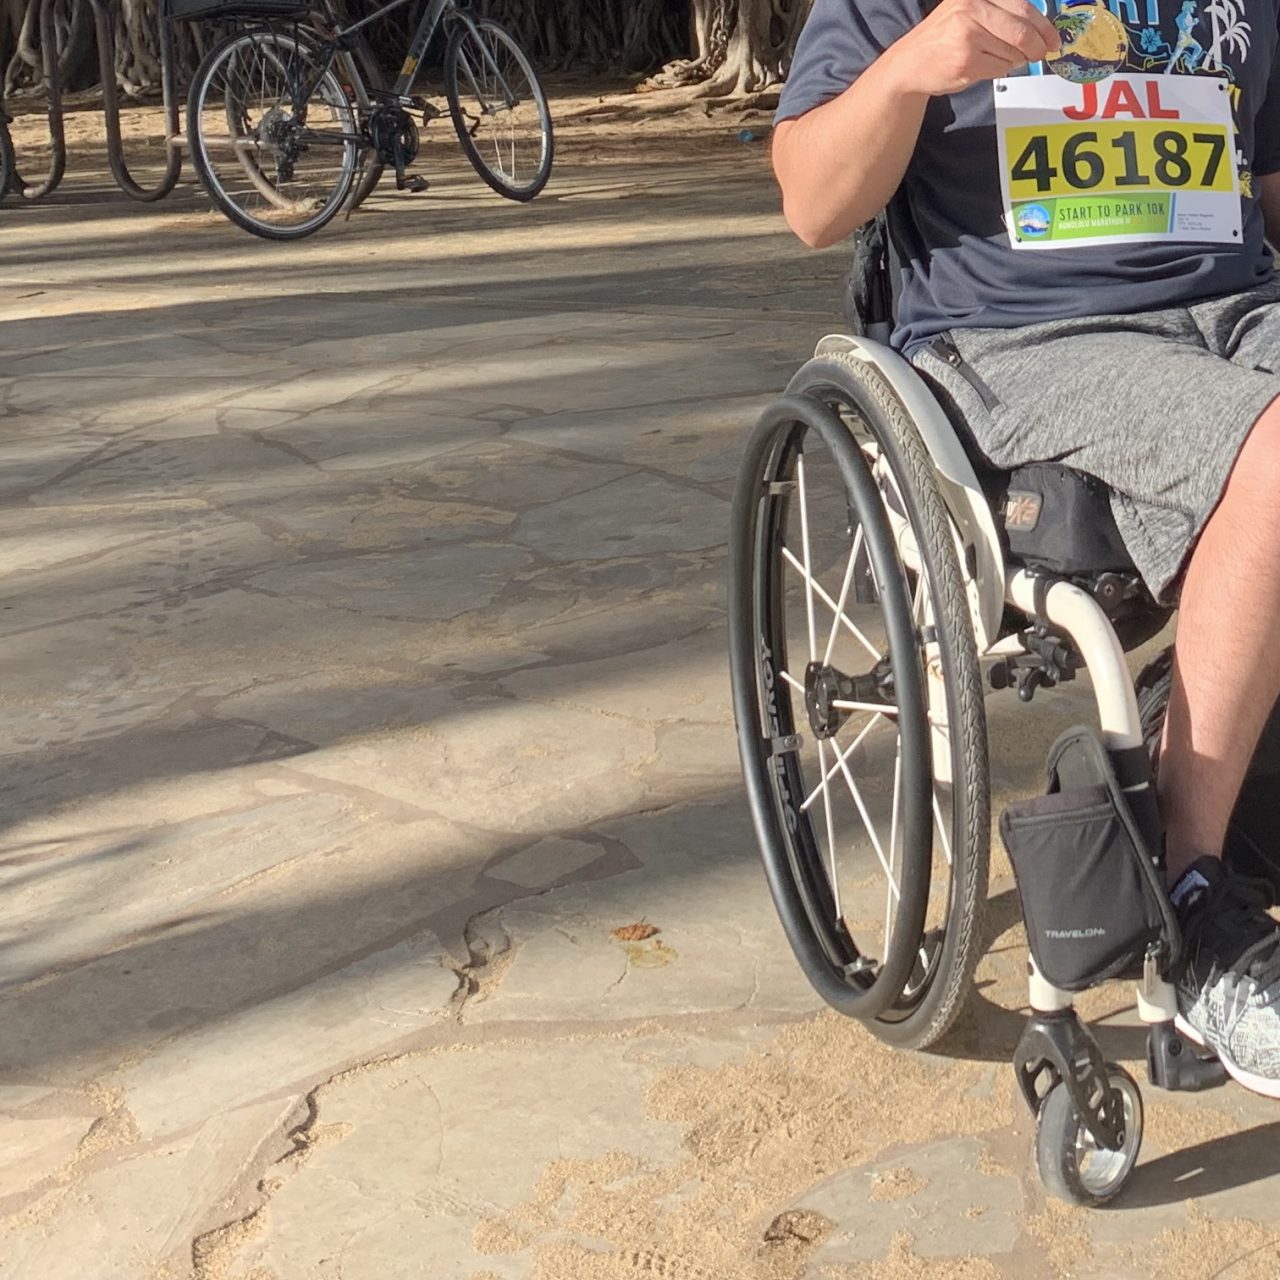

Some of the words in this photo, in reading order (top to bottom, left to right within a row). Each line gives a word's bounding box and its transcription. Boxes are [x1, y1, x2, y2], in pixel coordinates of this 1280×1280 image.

[1062, 80, 1180, 120] JAL
[1011, 131, 1226, 192] 46187
[1060, 206, 1092, 221] START
[1097, 205, 1110, 218] TO
[1115, 203, 1142, 217] PARK
[1147, 202, 1165, 216] 10K
